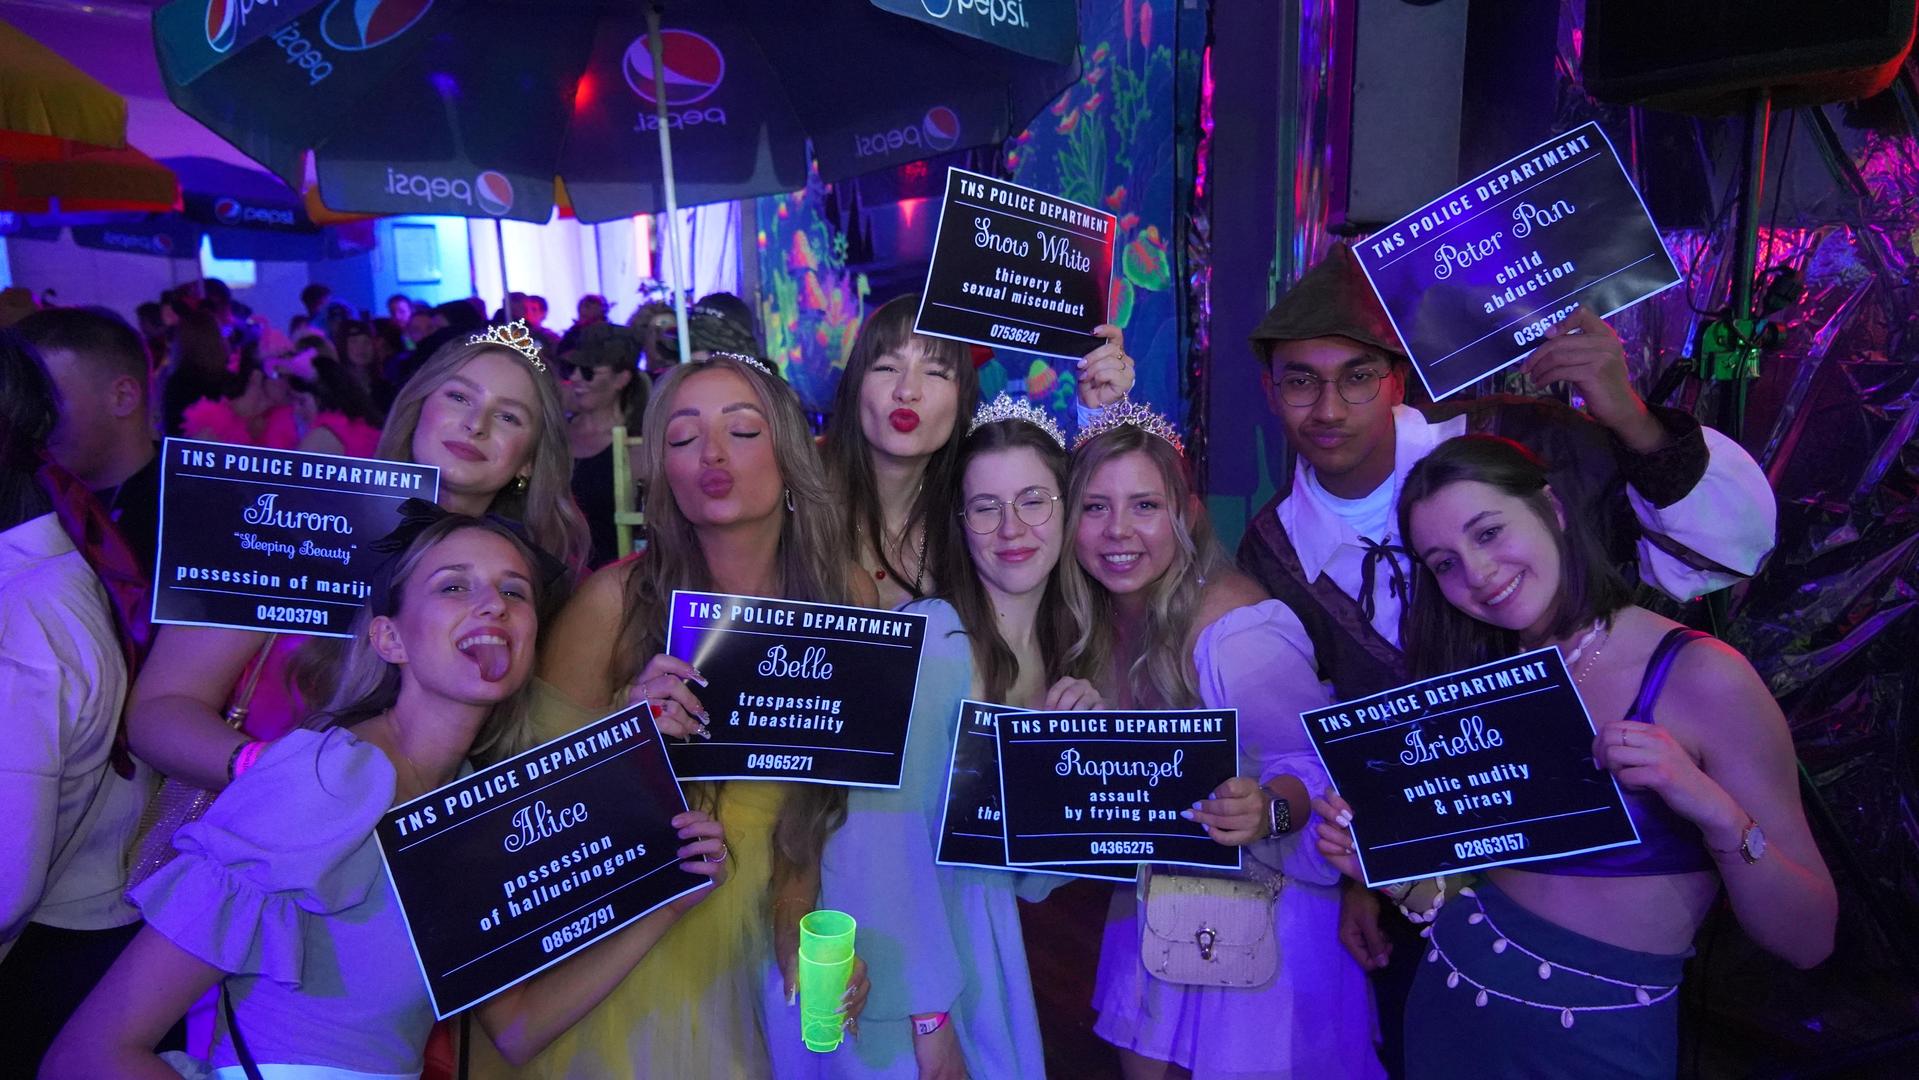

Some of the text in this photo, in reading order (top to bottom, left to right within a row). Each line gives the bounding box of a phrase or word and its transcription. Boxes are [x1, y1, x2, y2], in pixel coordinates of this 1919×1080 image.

[960, 179, 1109, 234] TNS POLICE DEPARTMENT
[1372, 135, 1590, 258] TNS POLICE DEPARTMENT
[974, 217, 1091, 273] Snow White
[1434, 199, 1576, 280] Peter Pan
[995, 267, 1062, 294] thievery &
[1495, 251, 1543, 285] child
[962, 281, 1084, 317] sexual misconduct
[1484, 260, 1575, 314] abduction
[990, 324, 1040, 345] 07536241
[181, 450, 422, 490] TNS POLICE DEPARTMENT
[243, 493, 352, 535] Aurora
[177, 566, 280, 588] possession
[290, 576, 308, 590] of
[256, 605, 329, 625] 04203791
[689, 602, 913, 638] TNS POLICE DEPARTMENT
[758, 644, 833, 680] Belle
[739, 692, 842, 714] trespassing
[1318, 661, 1548, 733] TNS POLICE DEPARTMENT
[730, 711, 844, 734] & beastiality
[975, 710, 996, 727] TN
[1011, 718, 1223, 734] TNS POLICE DEPARTMENT
[1399, 715, 1503, 766] Arielle
[395, 717, 642, 837] TNS POLICE DEPARTMENT
[747, 754, 813, 771] 04965271
[1055, 748, 1184, 787] Rapunzel
[1089, 790, 1150, 802] assault
[1403, 762, 1530, 803] public nudity
[1065, 806, 1177, 821] by frying pan
[1434, 789, 1513, 816] & piracy
[503, 801, 588, 853] Alice
[1090, 841, 1154, 855] 04365275
[1454, 832, 1525, 860] 02863157
[503, 834, 613, 898] possession
[480, 843, 647, 932] of hallucinogens
[541, 904, 616, 953] 08632791
